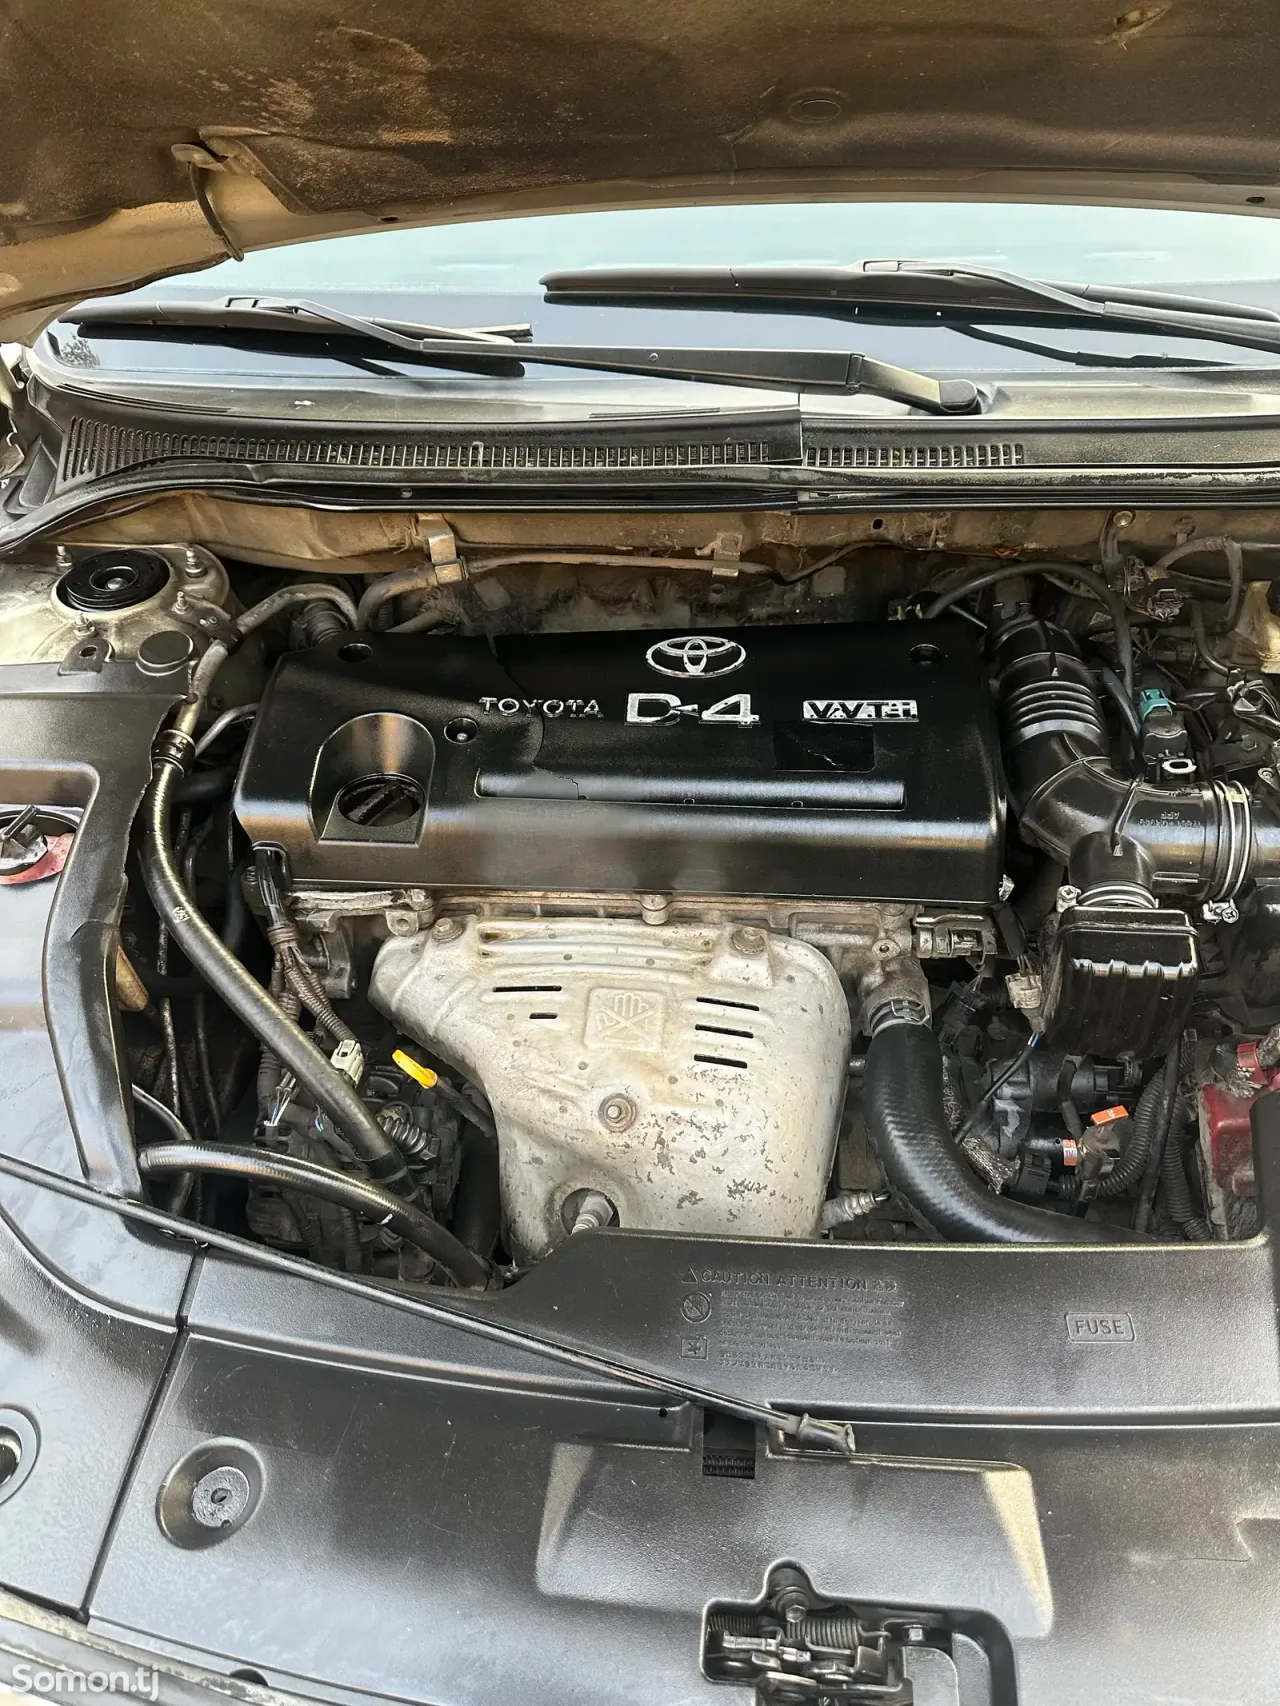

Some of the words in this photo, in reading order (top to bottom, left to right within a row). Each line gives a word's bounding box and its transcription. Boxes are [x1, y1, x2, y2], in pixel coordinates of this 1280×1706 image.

[478, 697, 604, 718] TOYOTA
[701, 1270, 770, 1286] CAUTION
[777, 1273, 868, 1292] ATTENTION
[1075, 1319, 1125, 1335] FUSE
